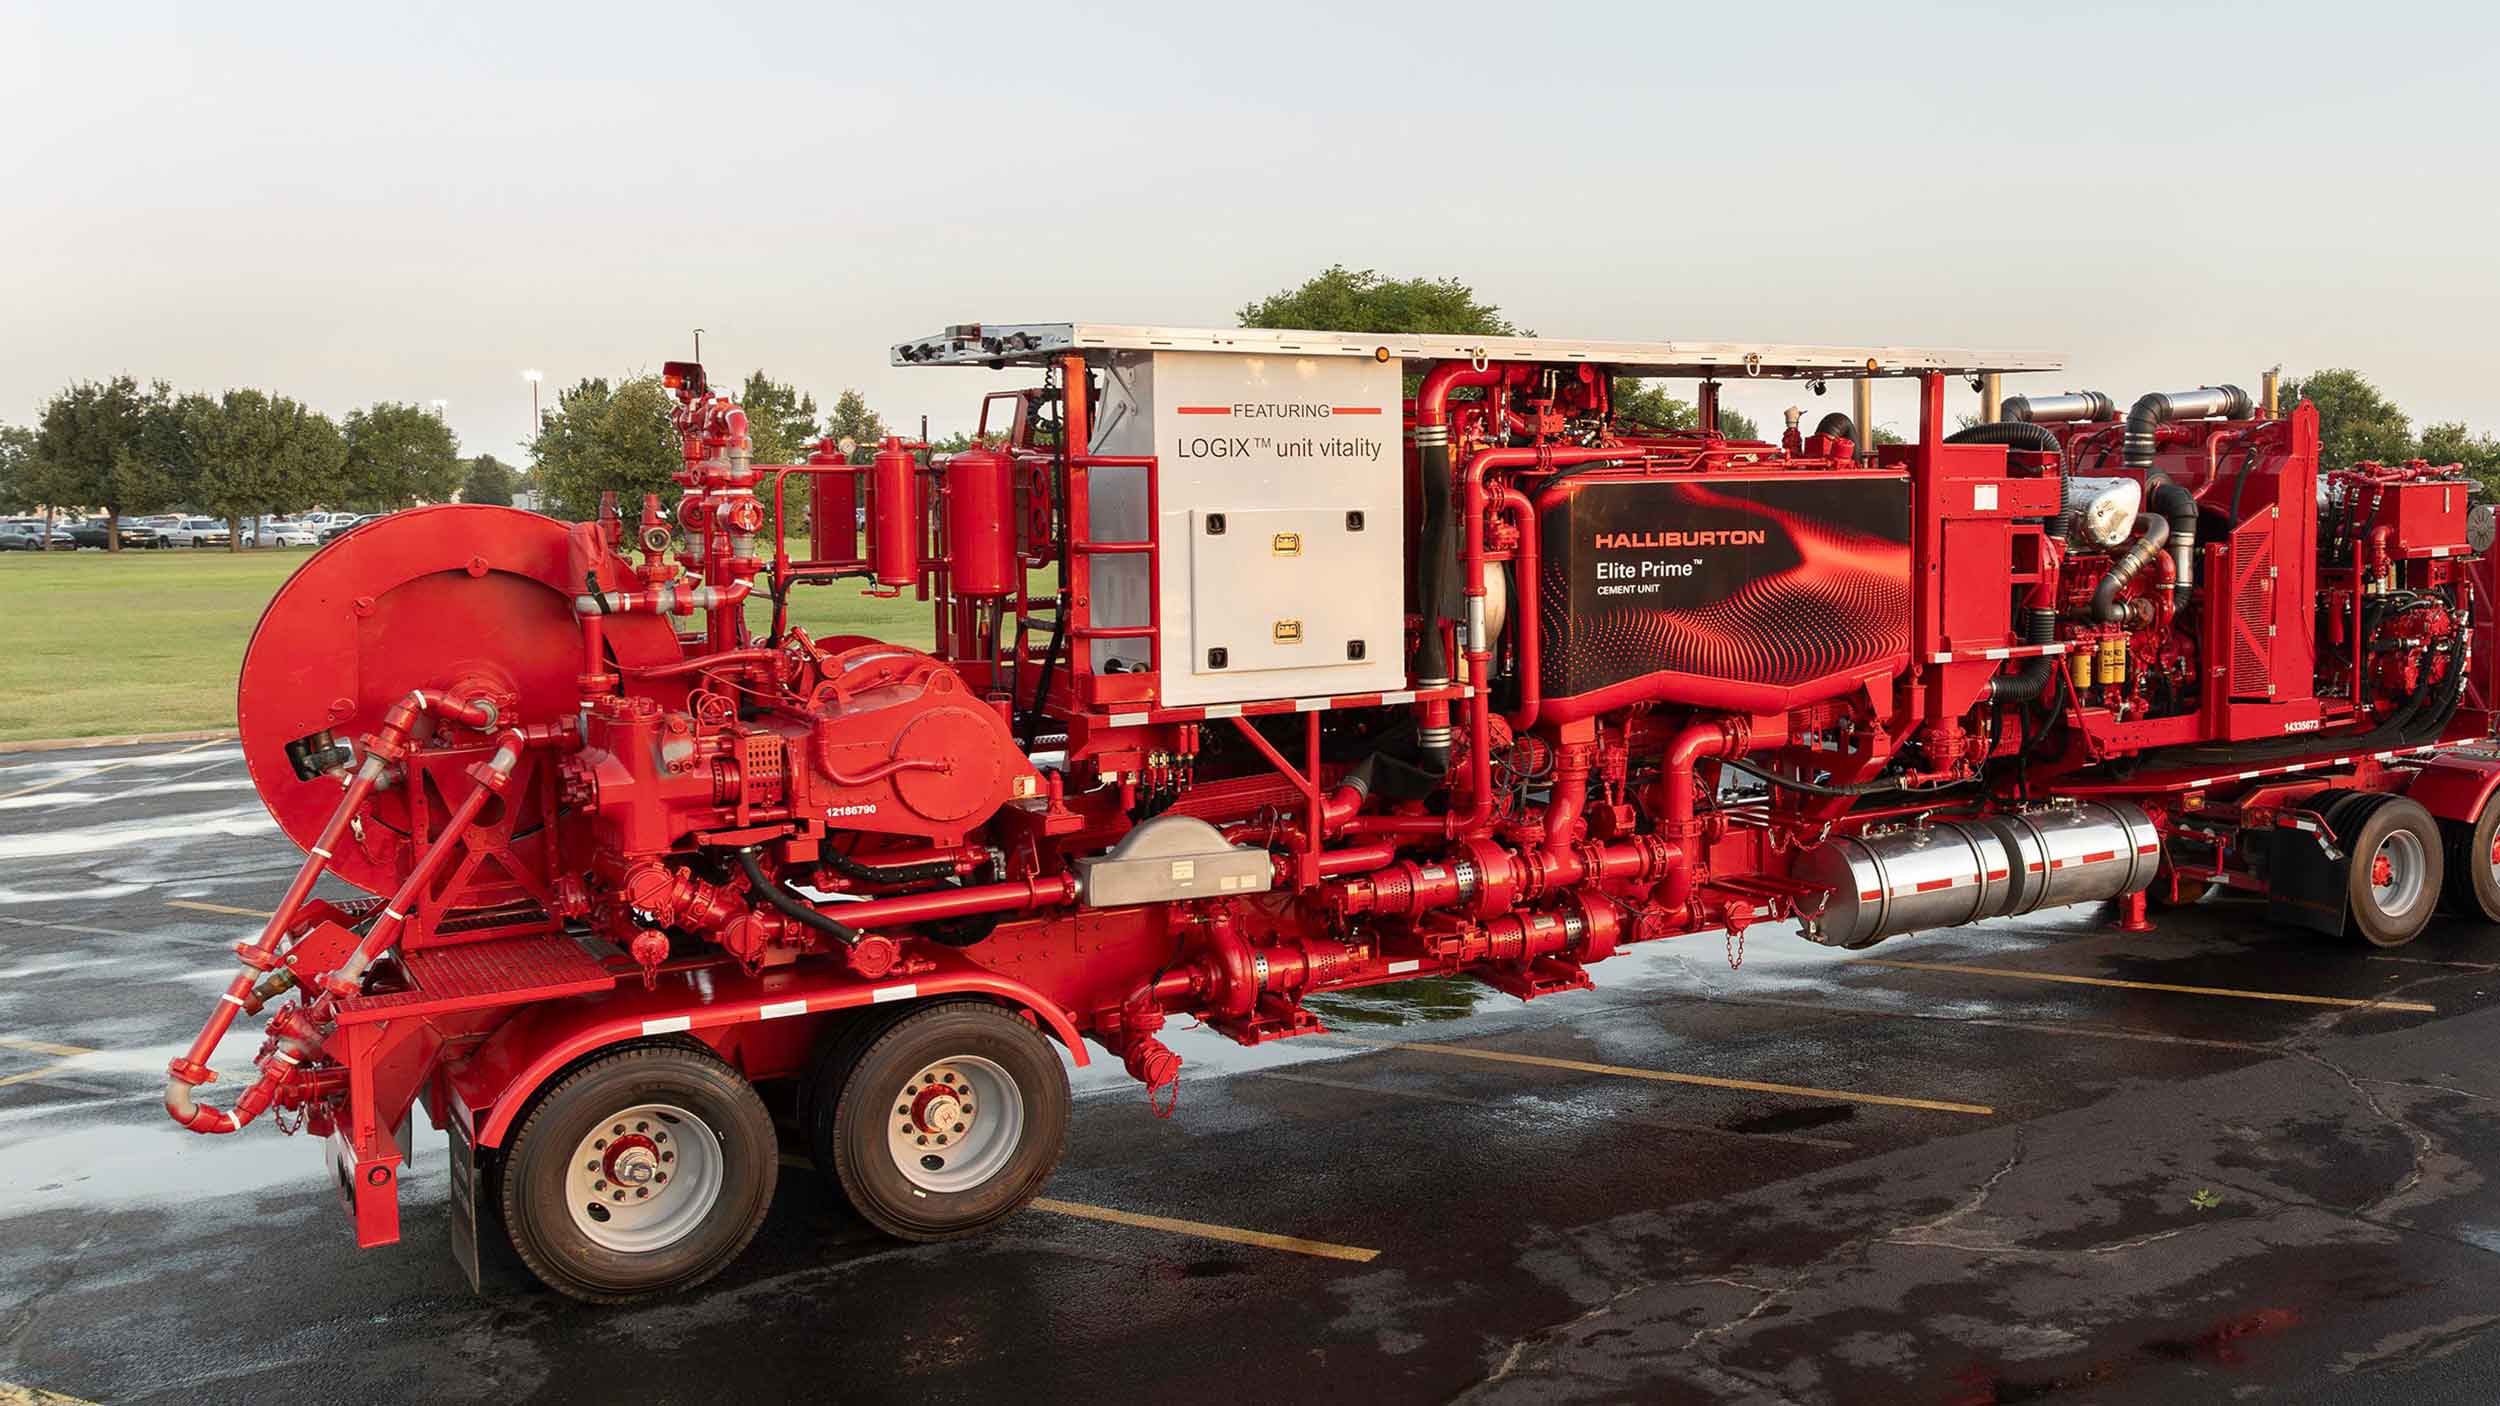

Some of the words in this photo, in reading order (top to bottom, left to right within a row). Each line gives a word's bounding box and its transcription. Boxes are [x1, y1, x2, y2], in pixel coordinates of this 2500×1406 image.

[1233, 403, 1330, 418] FEATURING
[1276, 438, 1313, 458] unit
[1319, 437, 1382, 462] vitality
[1595, 530, 1766, 549] HALLIBURTON
[1596, 562, 1636, 580] Elite
[1597, 584, 1636, 596] CEMENT
[1637, 583, 1661, 594] UNIT
[826, 804, 877, 817] 12186790
